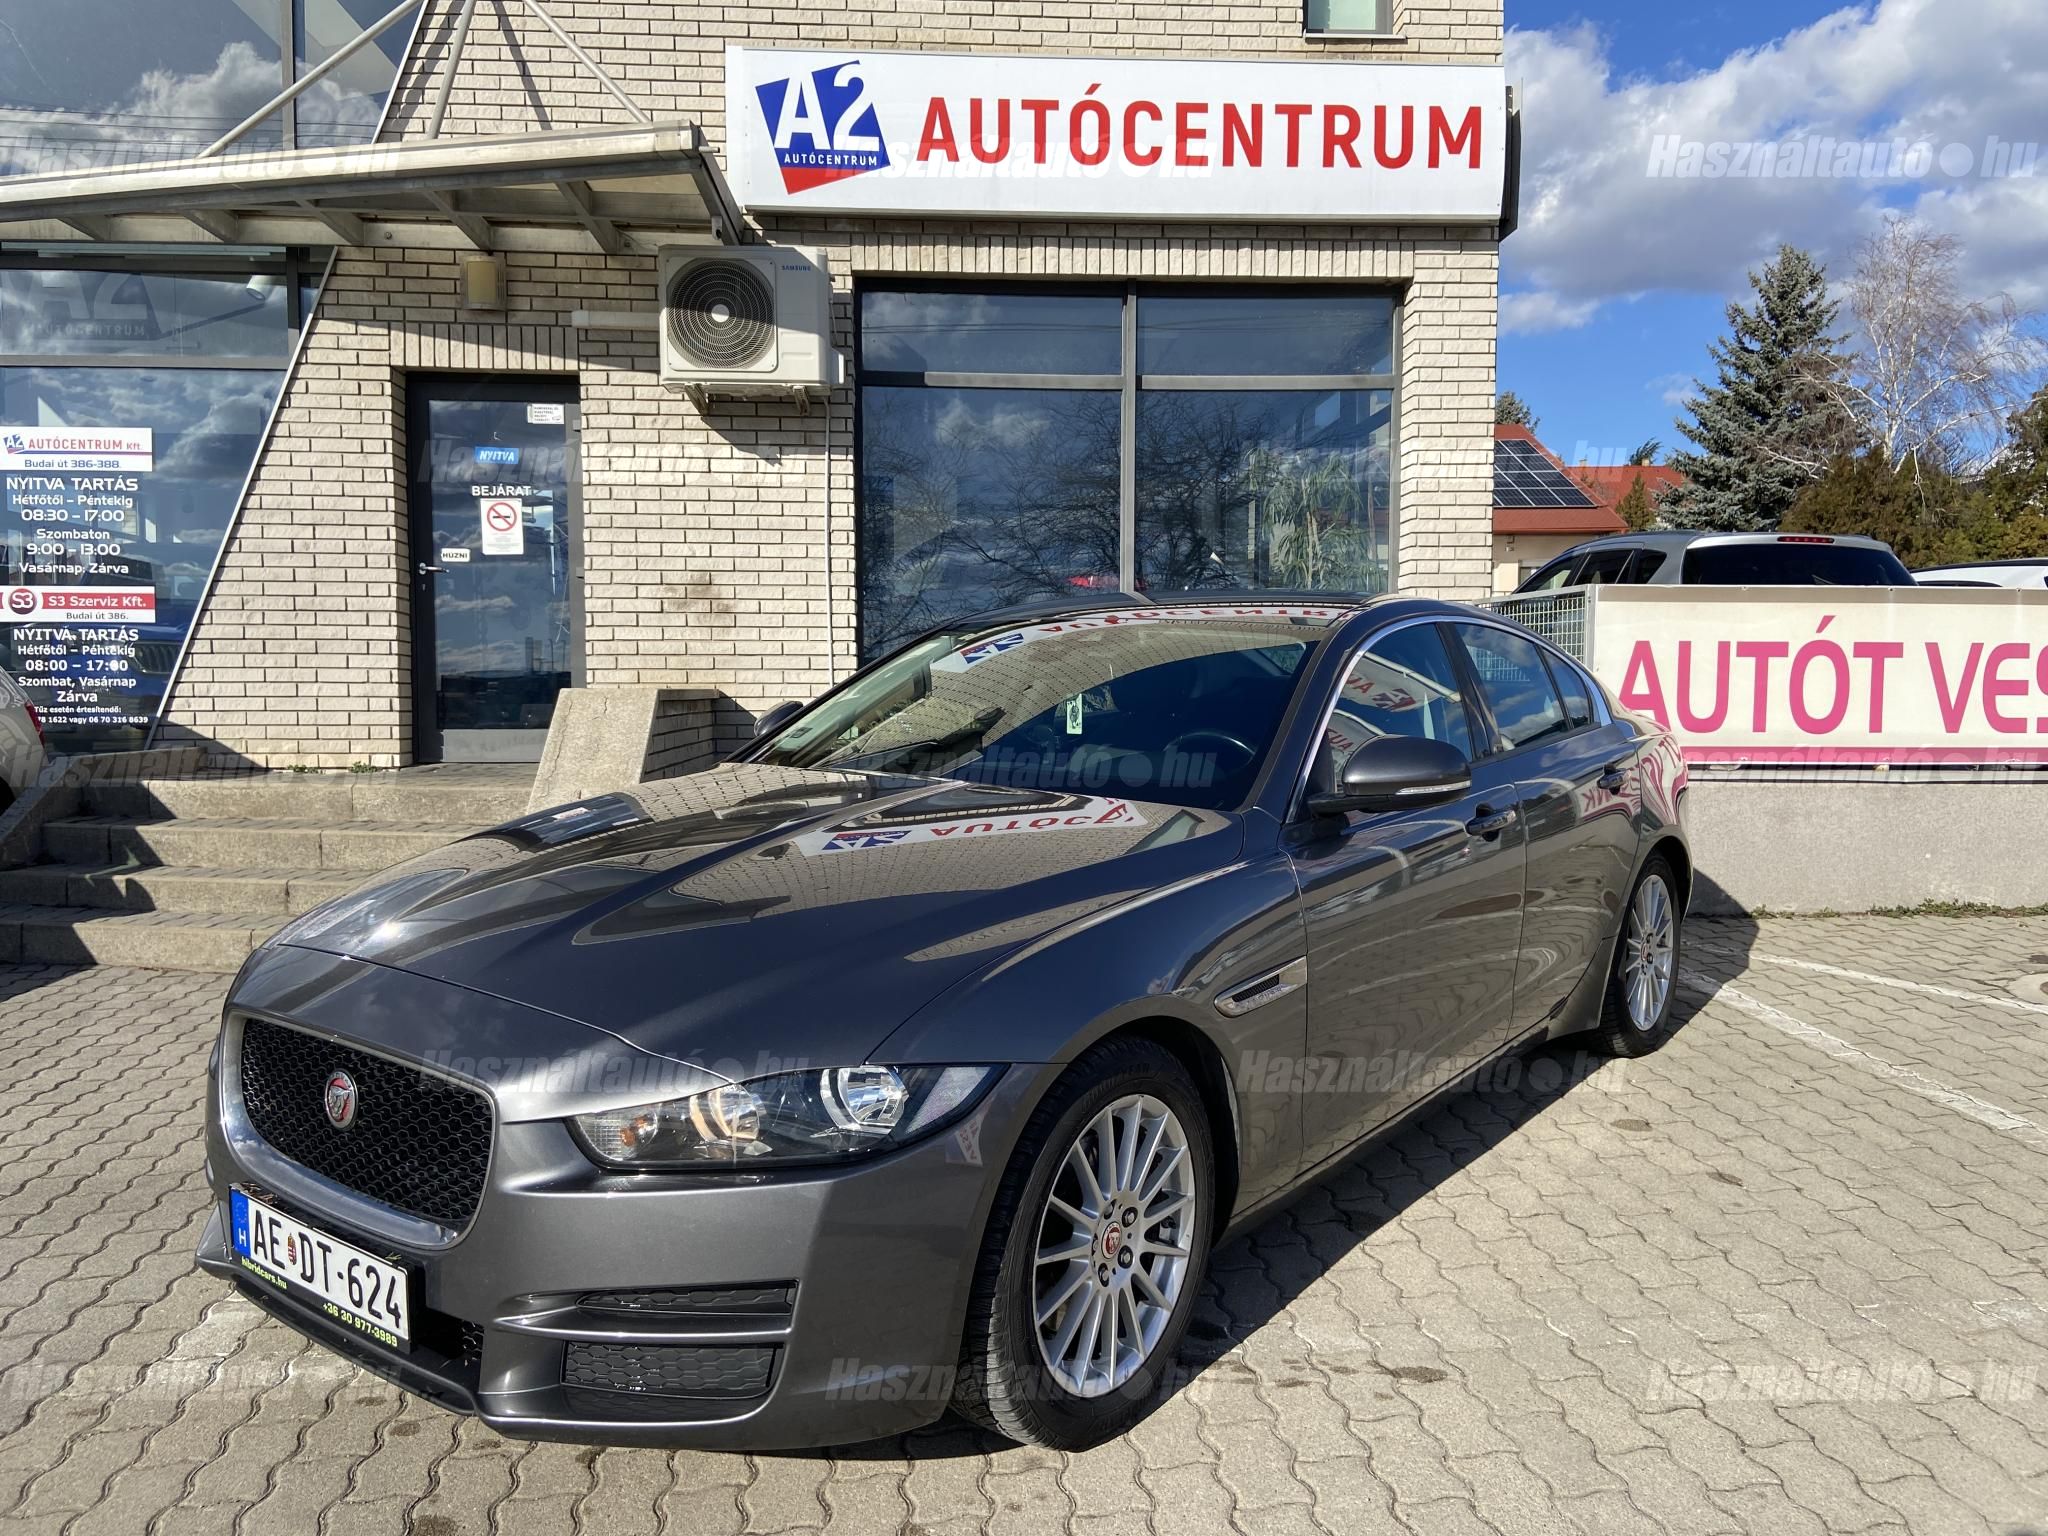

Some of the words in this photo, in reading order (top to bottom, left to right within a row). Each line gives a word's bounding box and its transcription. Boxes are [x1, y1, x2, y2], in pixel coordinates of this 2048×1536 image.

[774, 62, 880, 152] A2
[916, 83, 1483, 170] AUTÓCENTRUM
[783, 151, 878, 167] AUTÓCENTRUM
[6, 434, 24, 448] A2
[28, 436, 123, 450] AUTÓCENTRUM
[479, 450, 515, 462] NYITVA
[24, 459, 55, 468] Budai
[57, 459, 69, 468] út
[6, 477, 66, 490] NYITVA
[71, 475, 139, 492] TARTÁS
[471, 483, 532, 497] BEJÁRAT
[12, 494, 64, 505] Hétfőtől
[77, 495, 134, 508] Péntekig
[21, 509, 69, 521] 08:30
[84, 510, 125, 521] 17:00
[36, 528, 111, 540] Szombaton
[26, 543, 65, 555] 9:00
[80, 543, 121, 555] 13:00
[19, 562, 86, 575] Vasárnap:
[89, 562, 130, 574] Zárva
[11, 592, 34, 609] S3
[48, 596, 66, 607] S3
[69, 596, 119, 607] Szerviz
[122, 596, 147, 607] Kft.
[66, 612, 93, 620] Budai
[95, 612, 105, 620] út
[13, 628, 73, 641] NYITVA
[78, 625, 139, 641] TARTÁS
[18, 645, 67, 656] Hétfőtől
[82, 645, 136, 658] Péntekig
[25, 660, 68, 672] 08:00
[86, 660, 129, 672] 17:00
[1618, 615, 1904, 735] AUTÓT
[1924, 641, 2048, 734] VE
[18, 676, 76, 688] Szombat,
[79, 676, 137, 689] Vasárnap
[57, 690, 98, 703] Zárva
[34, 705, 48, 713] Tűz
[49, 705, 75, 713] esetén
[48, 716, 68, 724] 1622
[69, 717, 87, 725] vagy
[88, 716, 99, 724] 06
[100, 716, 111, 724] 70
[112, 716, 128, 724] 316
[238, 1227, 247, 1247] H
[241, 1255, 288, 1290] hibridcars.hu
[253, 1209, 286, 1270] AE
[298, 1231, 402, 1330] DT-624
[322, 1301, 339, 1317] +36
[340, 1309, 353, 1325] 30
[354, 1316, 398, 1348] 977-3989
